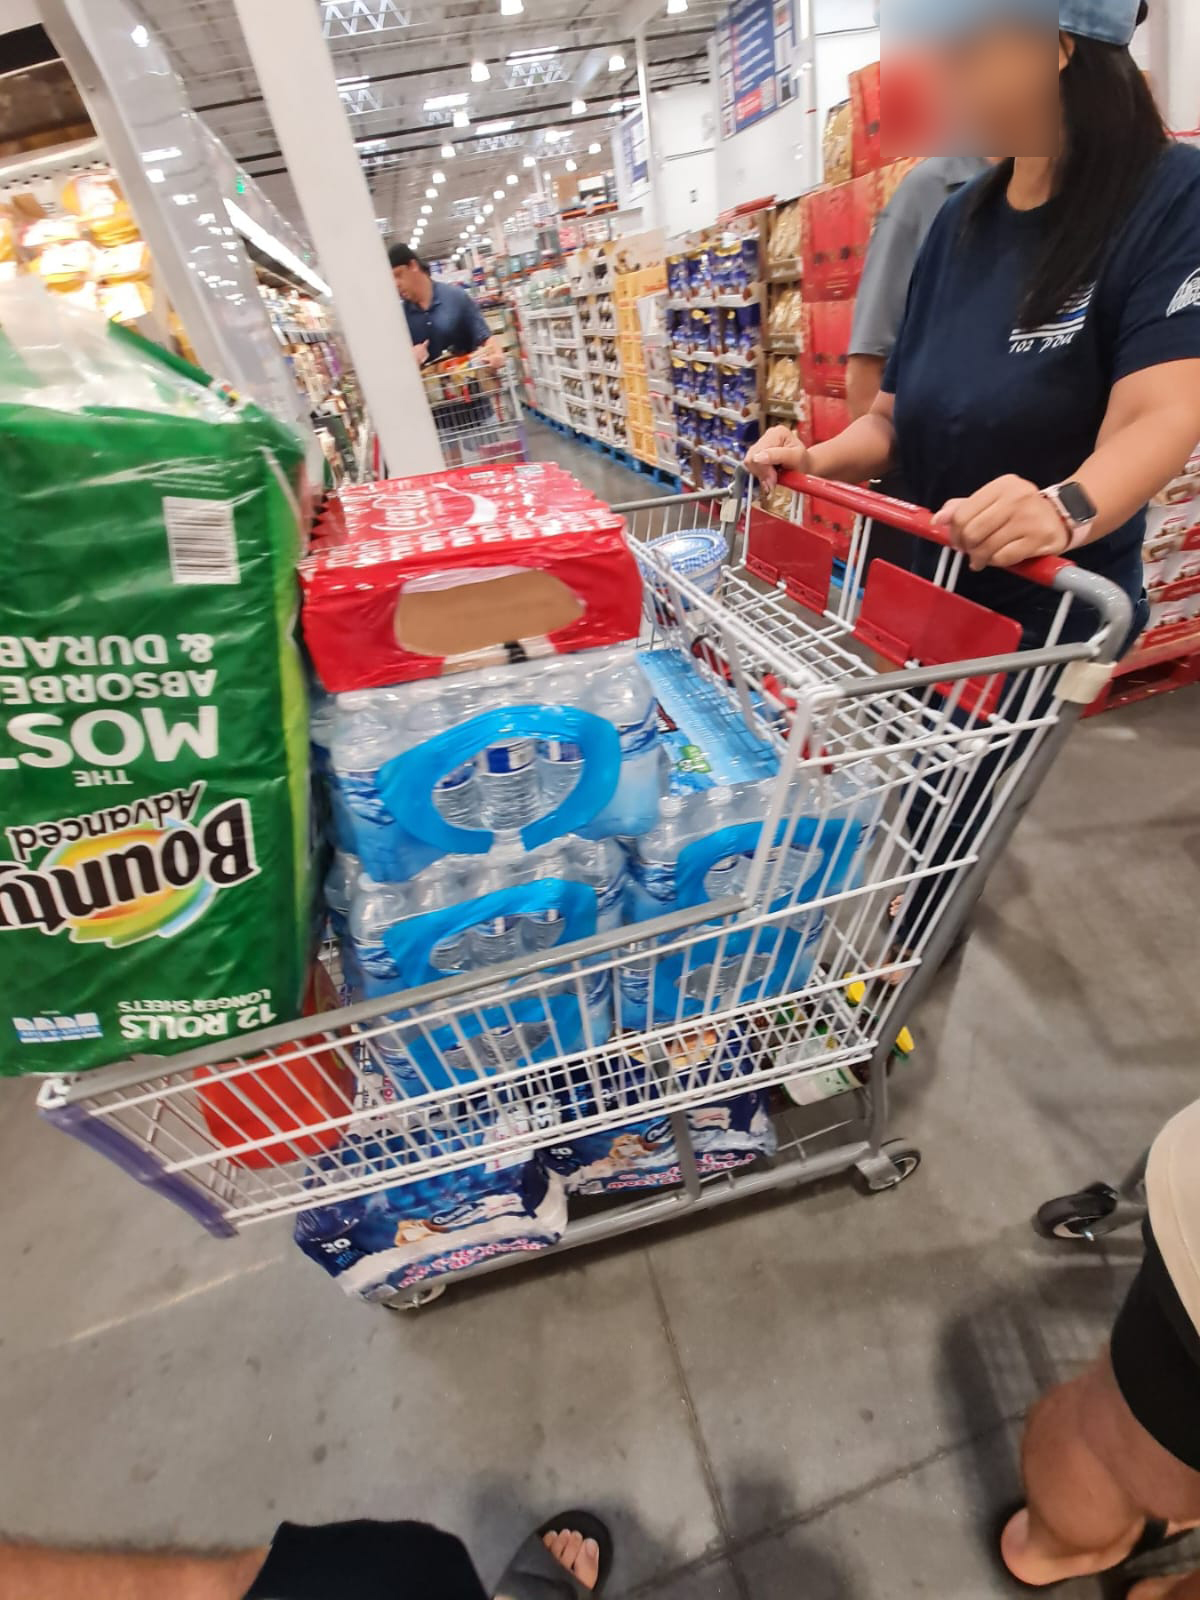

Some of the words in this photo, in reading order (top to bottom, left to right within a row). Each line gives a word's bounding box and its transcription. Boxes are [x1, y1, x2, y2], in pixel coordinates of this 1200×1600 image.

[177, 633, 215, 663] &
[72, 770, 133, 787] THE
[11, 783, 205, 861] Advanced
[117, 1001, 190, 1013] SHEETS
[193, 989, 272, 1013] LONGER
[120, 1012, 229, 1041] ROLLS
[236, 1004, 277, 1029] 12
